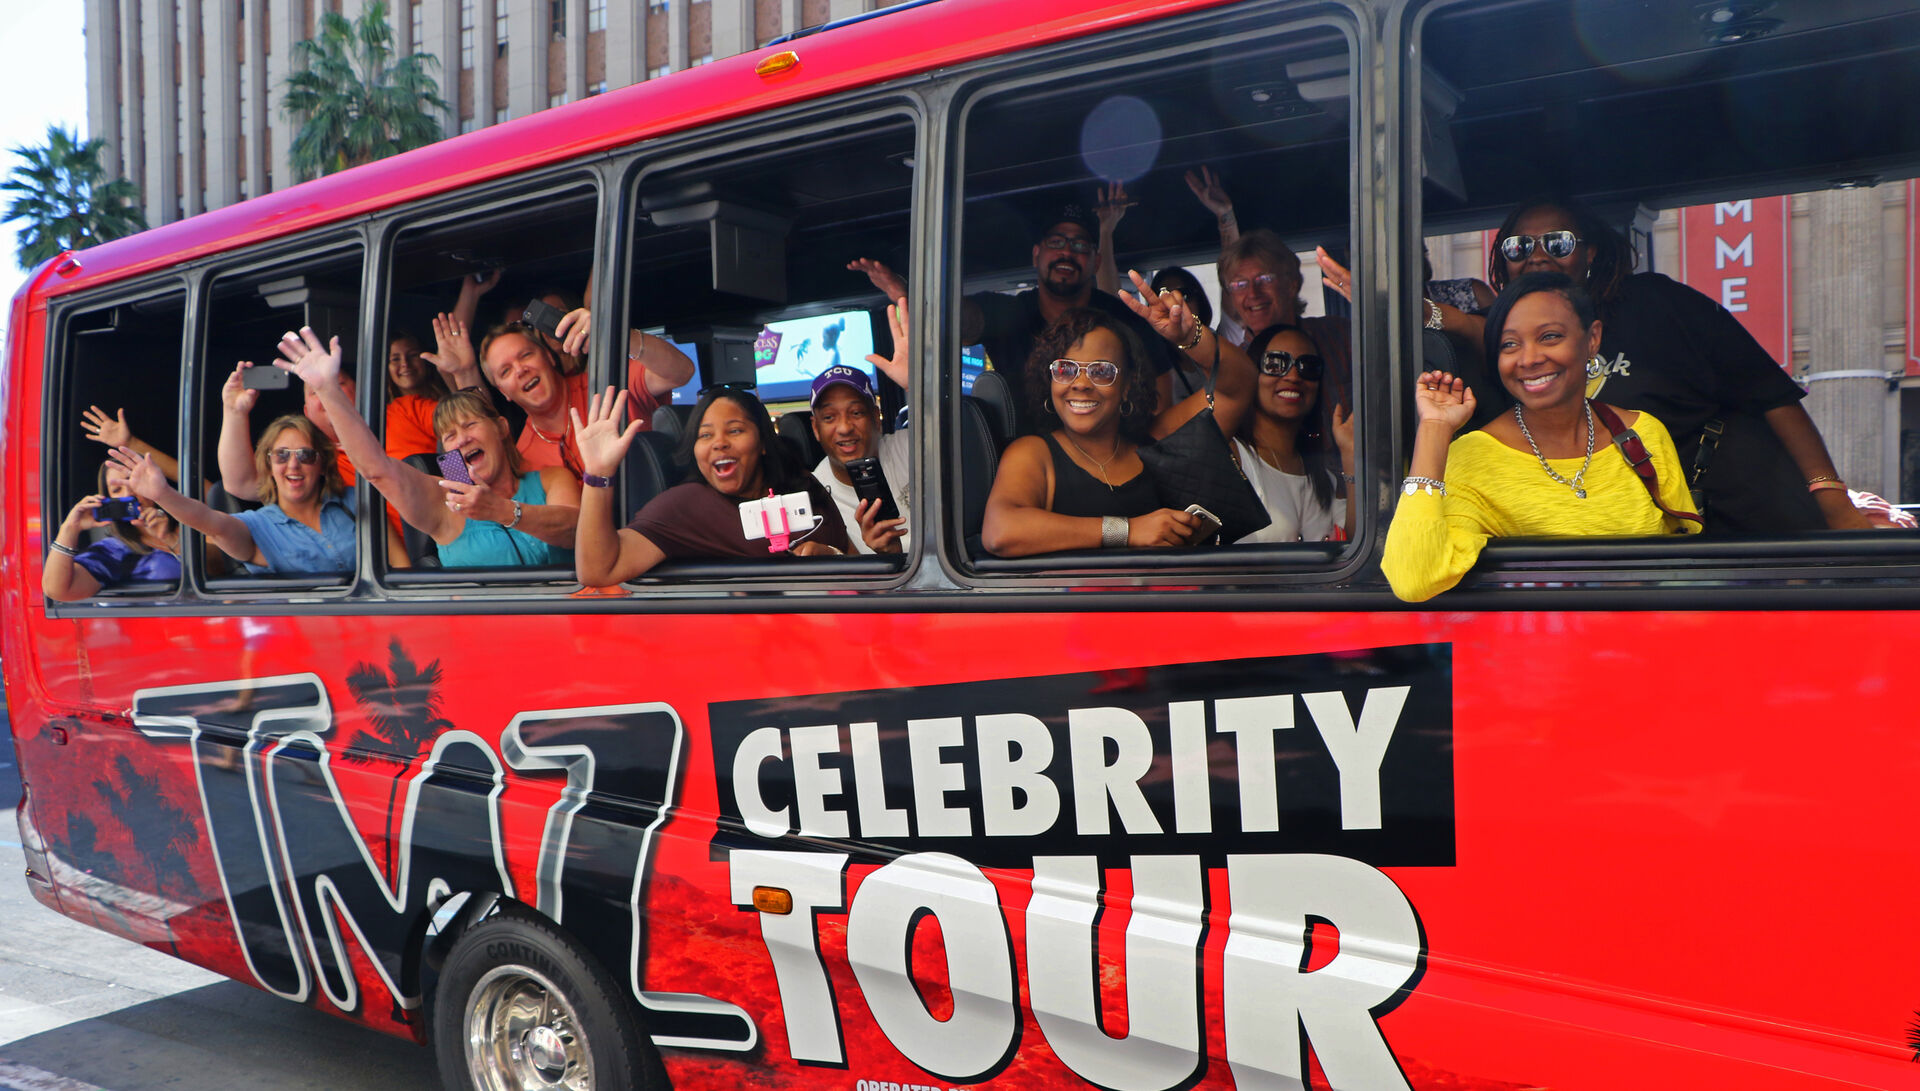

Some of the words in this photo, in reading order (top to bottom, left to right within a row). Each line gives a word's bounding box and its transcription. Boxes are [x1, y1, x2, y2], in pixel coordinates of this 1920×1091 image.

[754, 336, 778, 349] CESS
[824, 367, 852, 379] TCU
[731, 685, 1411, 838] CELEBRITY
[132, 672, 758, 1052] TMZ
[729, 850, 1424, 1091] TOUR
